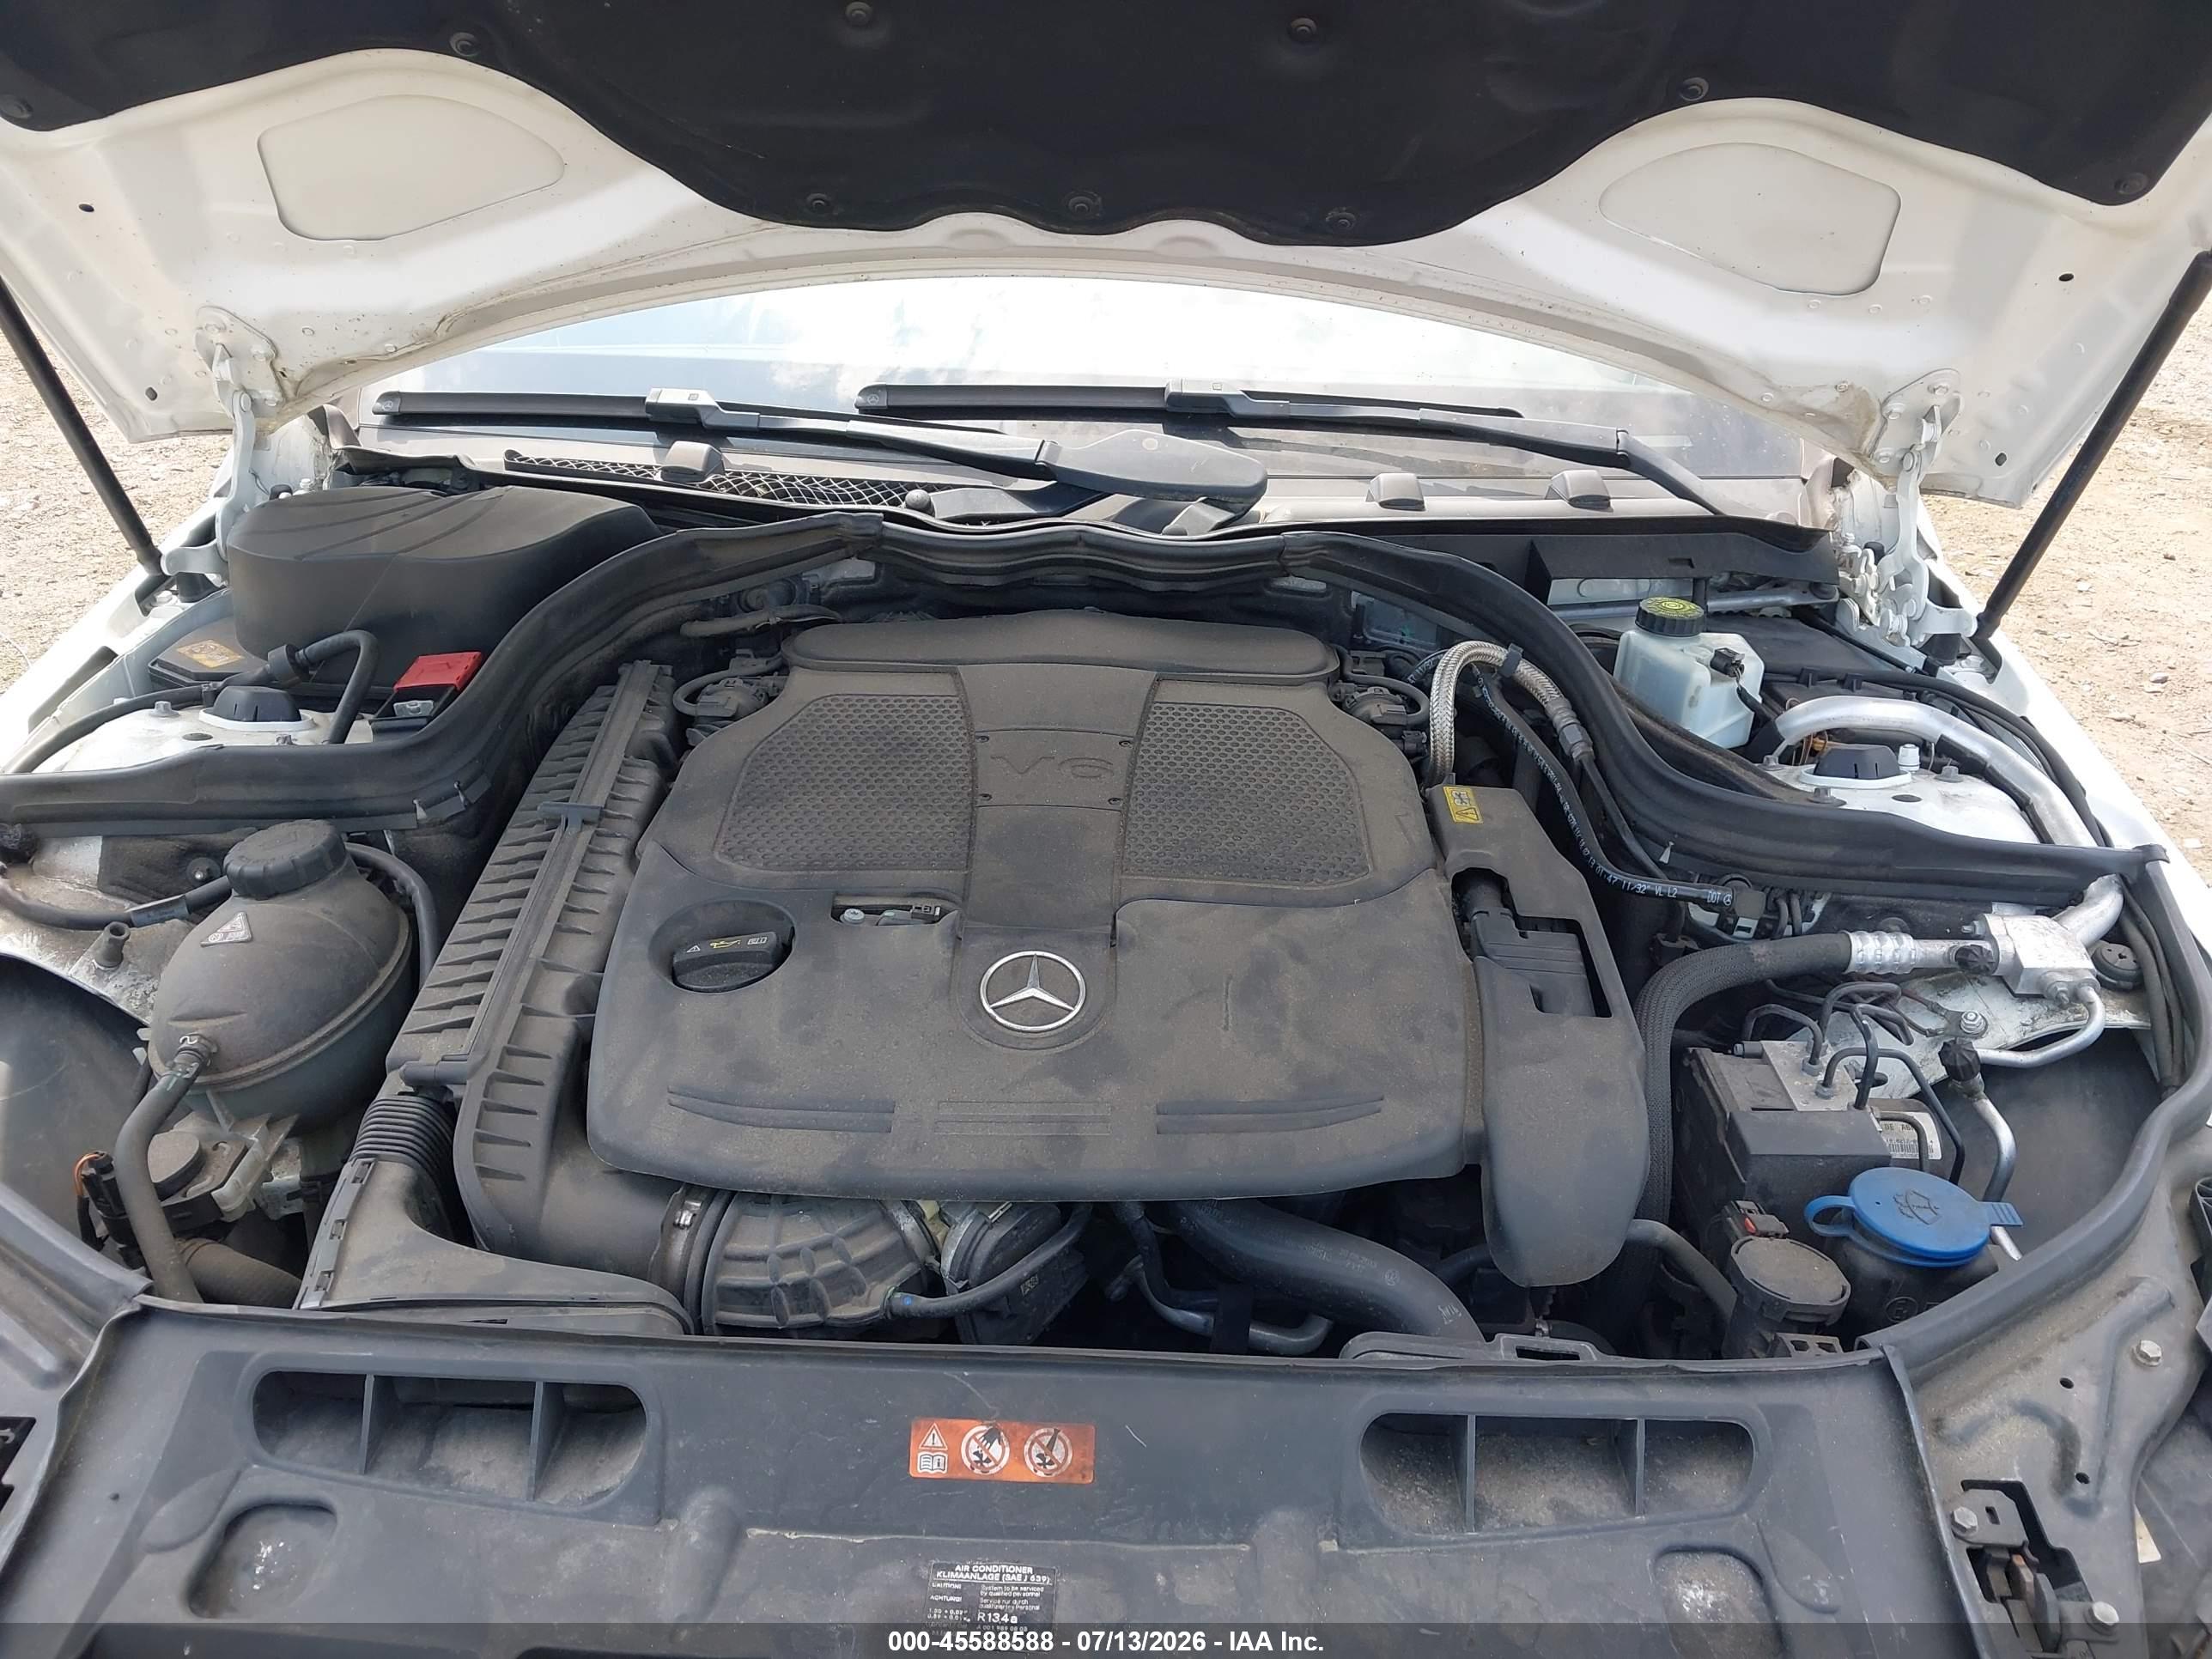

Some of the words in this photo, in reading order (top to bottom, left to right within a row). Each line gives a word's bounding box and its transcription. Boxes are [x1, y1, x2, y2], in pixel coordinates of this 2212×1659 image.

[1707, 889, 1722, 903] DOT
[972, 1565, 1034, 1574] CONDITIONER
[936, 1571, 1000, 1581] KLIMAANLAGE
[1002, 1573, 1022, 1583] (SAE
